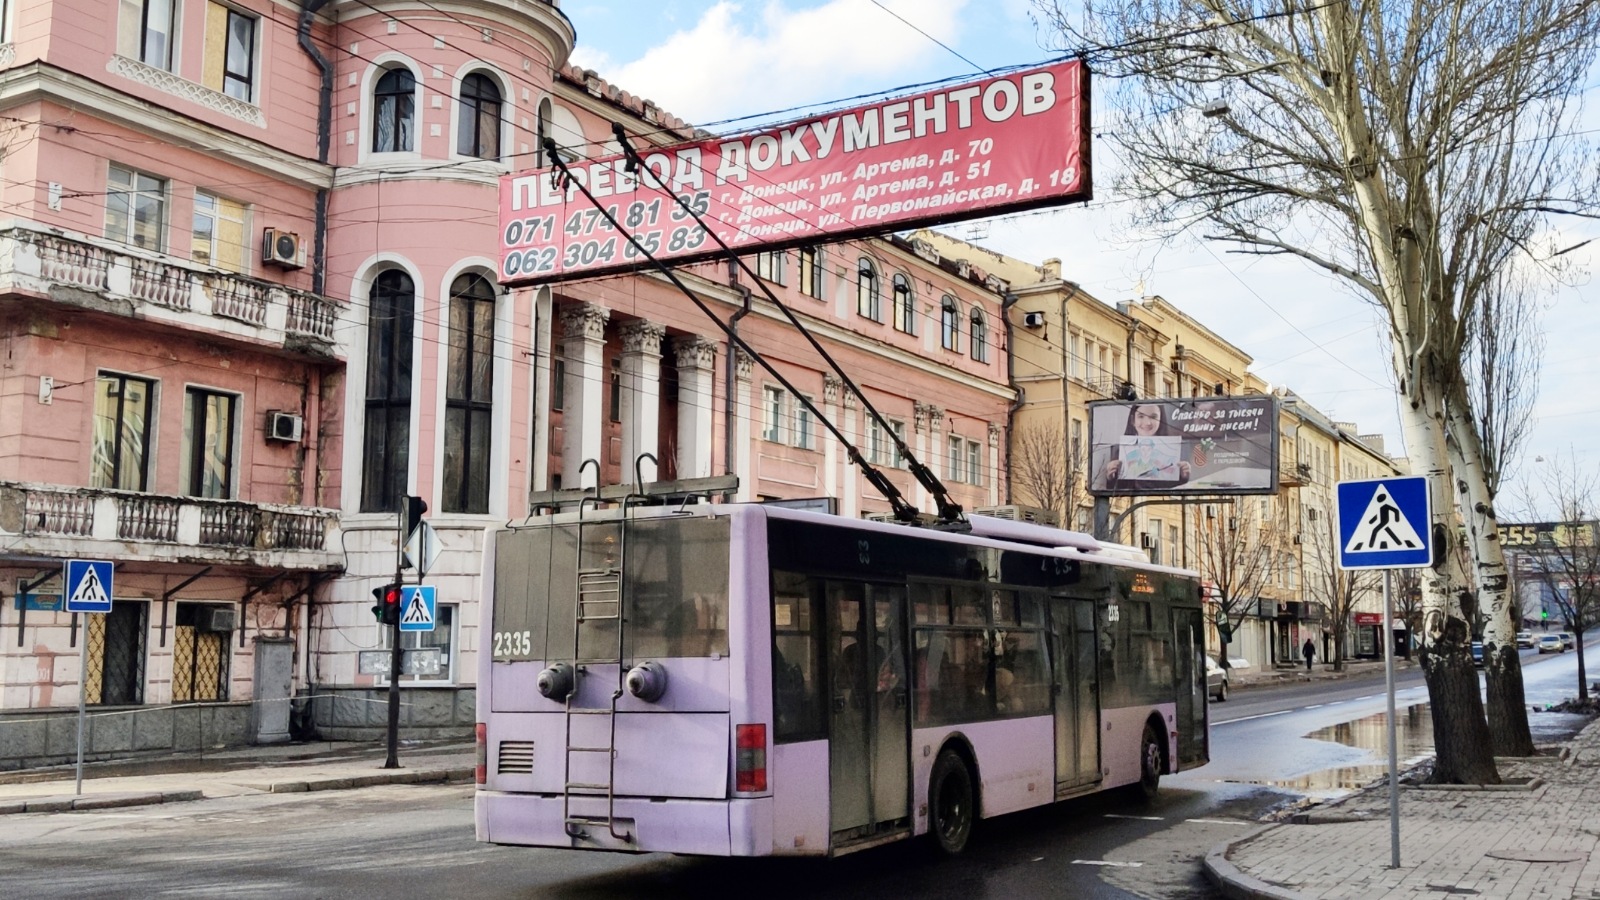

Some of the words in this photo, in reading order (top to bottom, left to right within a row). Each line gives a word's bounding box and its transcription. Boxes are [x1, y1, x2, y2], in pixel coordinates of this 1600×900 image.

[512, 148, 703, 211] ПЕРЕВОД
[716, 71, 1057, 185] ДОКУМЕНТОВ
[718, 212, 733, 224] г.
[736, 197, 815, 224] Донецк,
[819, 191, 847, 209] ул.
[852, 174, 934, 203] Артема,
[939, 168, 960, 188] д.
[967, 159, 991, 179] 51
[720, 192, 734, 204] г.
[738, 175, 815, 204] Донецк,
[819, 171, 847, 188] ул.
[852, 152, 935, 182] Артема,
[939, 145, 960, 166] д.
[968, 137, 993, 156] 70
[505, 215, 556, 246] 071
[565, 204, 619, 239] 474
[625, 197, 663, 229] 81
[671, 189, 711, 222] 35
[734, 217, 813, 242] Донецк,
[818, 213, 845, 230] ул.
[851, 184, 1013, 220] Первомайская,
[1019, 175, 1040, 196] д.
[1048, 167, 1075, 188] 18
[504, 246, 557, 277] 062
[562, 236, 617, 270] 304
[624, 230, 664, 262] 65
[667, 224, 707, 253] 83
[1172, 408, 1211, 420] Спасибо
[1213, 409, 1225, 419] за
[1229, 408, 1264, 418] тысячи
[1183, 423, 1216, 432] ваших
[1220, 418, 1259, 431] писем!
[494, 631, 531, 657] 2335
